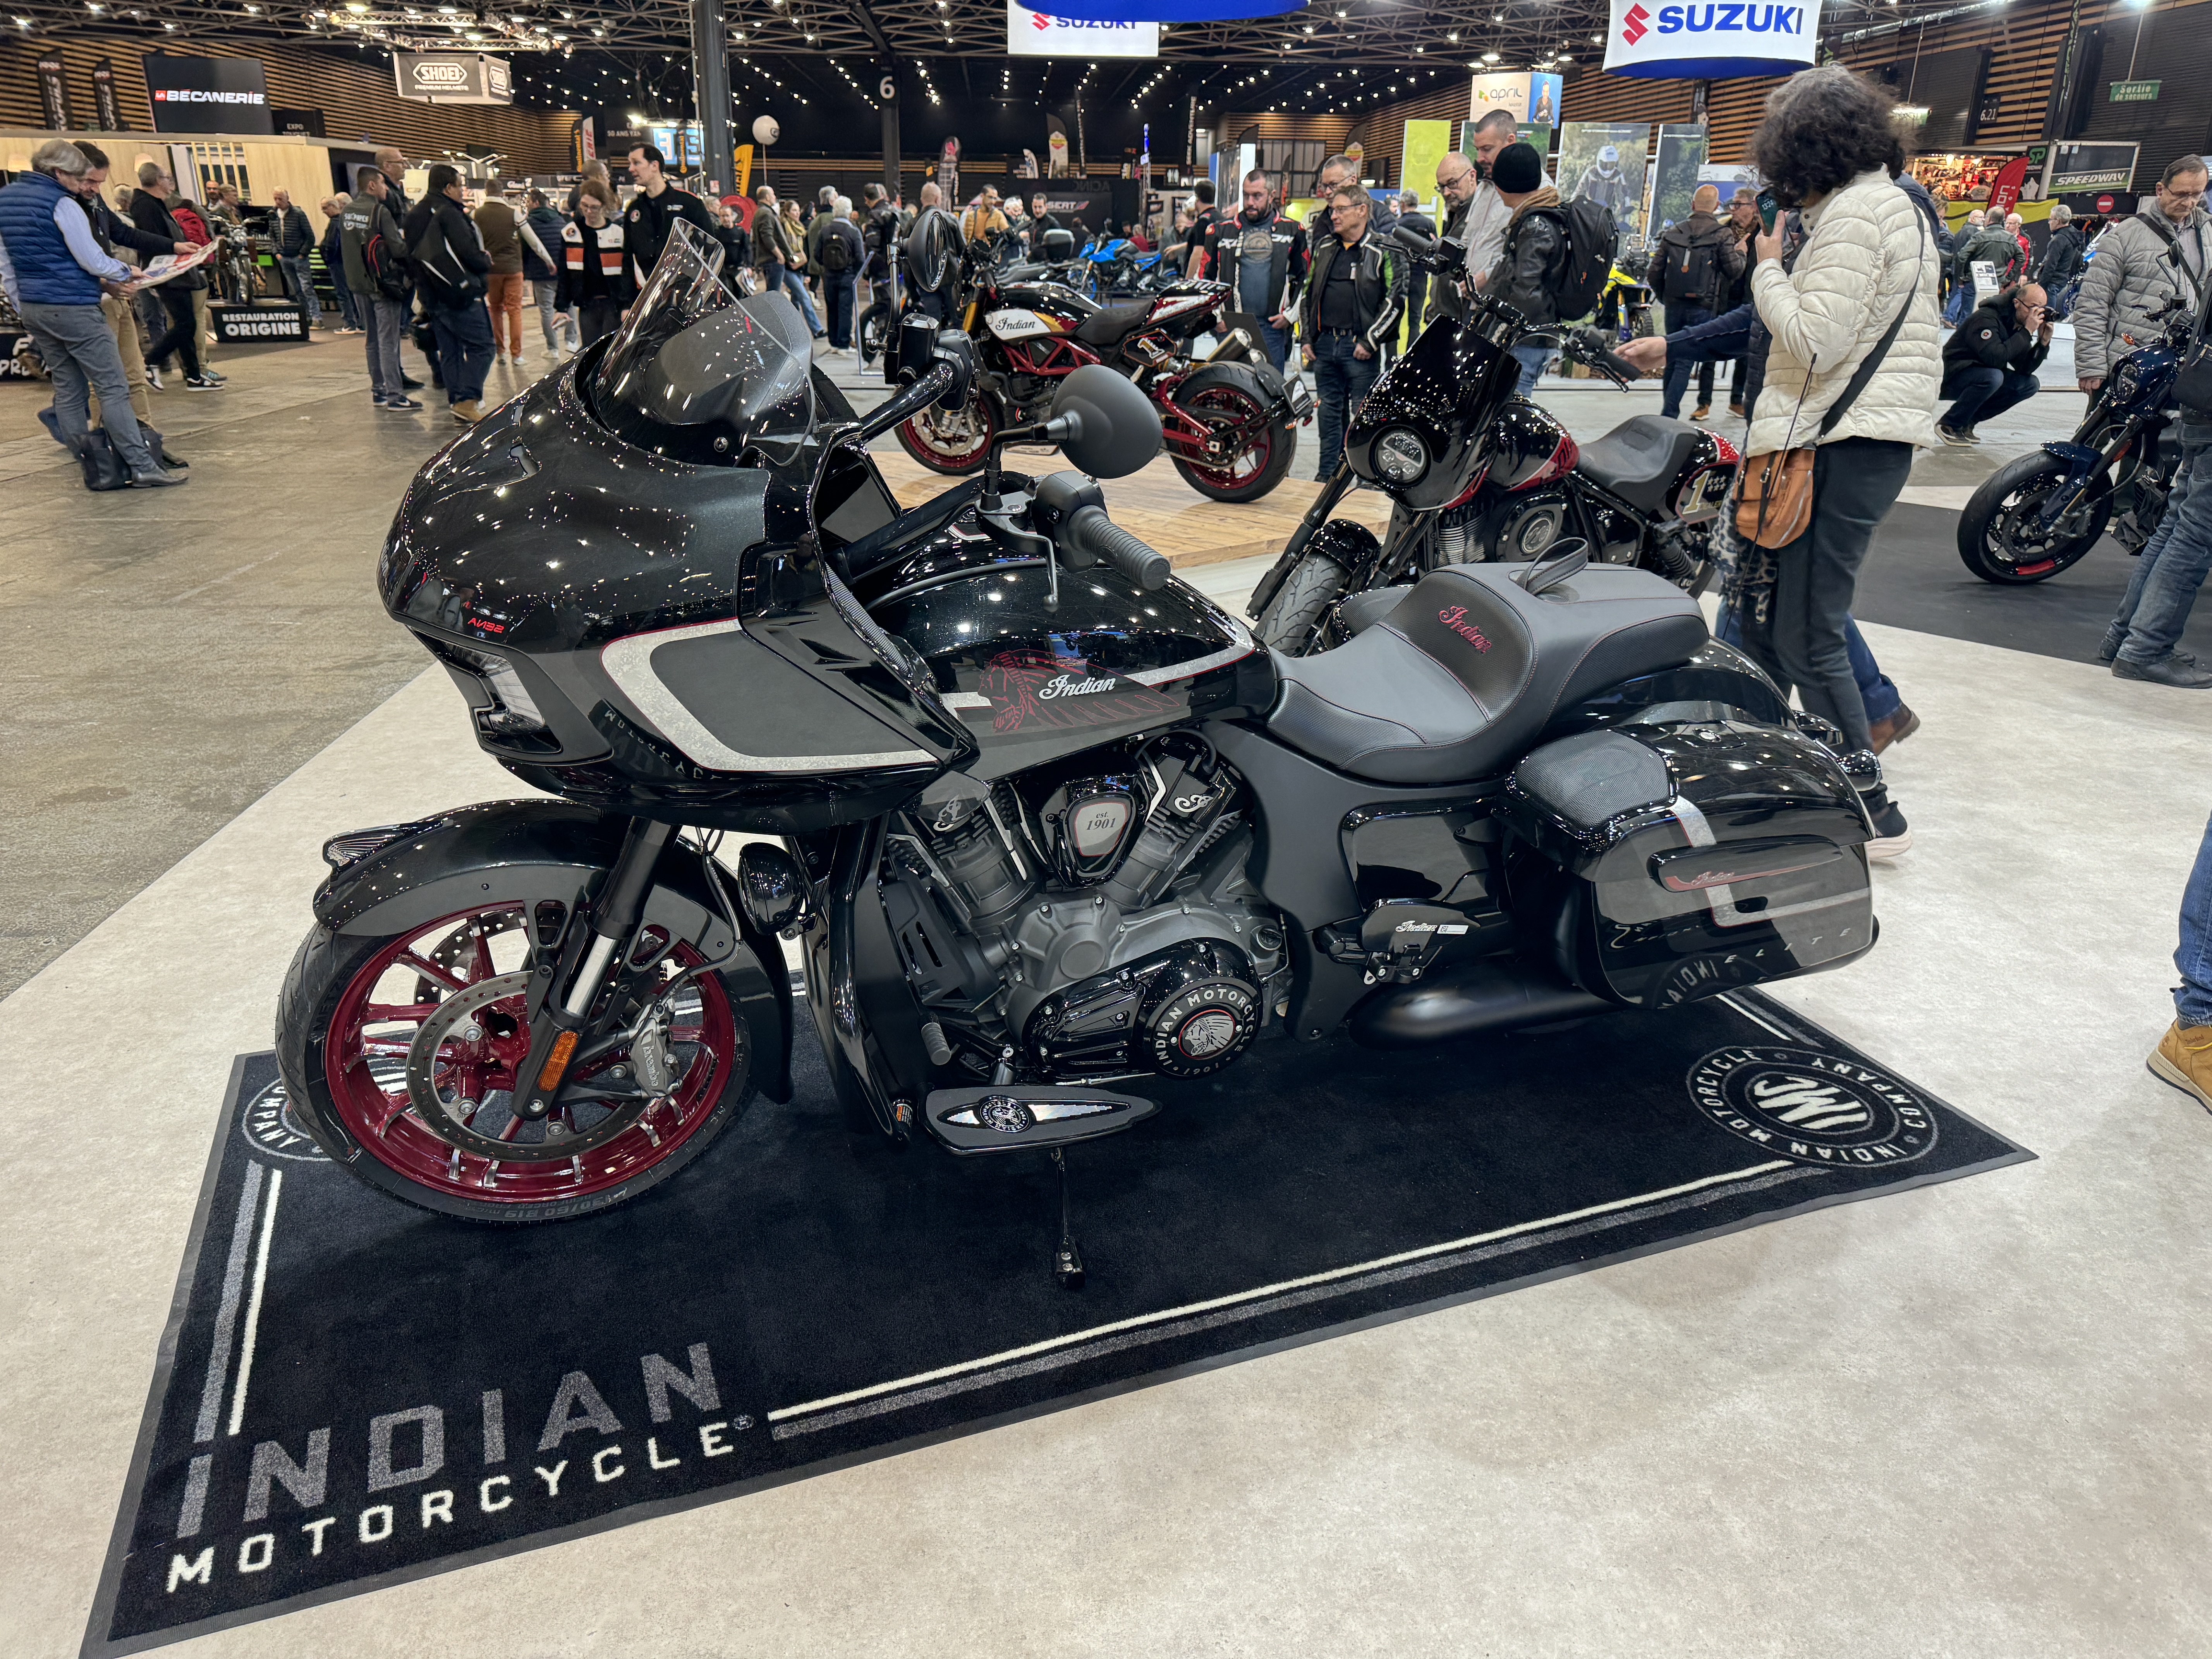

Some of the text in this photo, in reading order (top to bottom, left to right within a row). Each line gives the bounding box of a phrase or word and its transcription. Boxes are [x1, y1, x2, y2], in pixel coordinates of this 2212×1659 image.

[1657, 4, 1803, 34] SUZUKI
[420, 66, 460, 81] SHOEI
[879, 77, 895, 99] 6
[1490, 88, 1522, 101] april
[2120, 84, 2151, 93] Sortie
[1980, 109, 1996, 121] 6.21
[2055, 172, 2126, 186] SPEEDWAY
[222, 313, 300, 322] RESTAURATION
[995, 317, 1036, 331] Indian
[225, 322, 302, 336] ORIGINE
[1682, 470, 1711, 515] 1
[1438, 606, 1492, 654] Indian
[1039, 674, 1115, 699] Indian
[1096, 811, 1109, 819] est.
[1086, 818, 1116, 831] 1901
[1396, 920, 1437, 932] Indian
[1724, 928, 1851, 963] ELITE
[1156, 989, 1254, 1065] INDIAN MOTORCYCLE
[643, 1046, 659, 1087] brembo
[1183, 1063, 1219, 1075] 1901
[982, 1100, 1012, 1124] MOTORCYCLE
[1697, 1049, 1927, 1162] INDIAN MOTORCYCLE COMPANY
[176, 1342, 723, 1538] INDIAN
[168, 1420, 736, 1593] MOTORCYCLE
